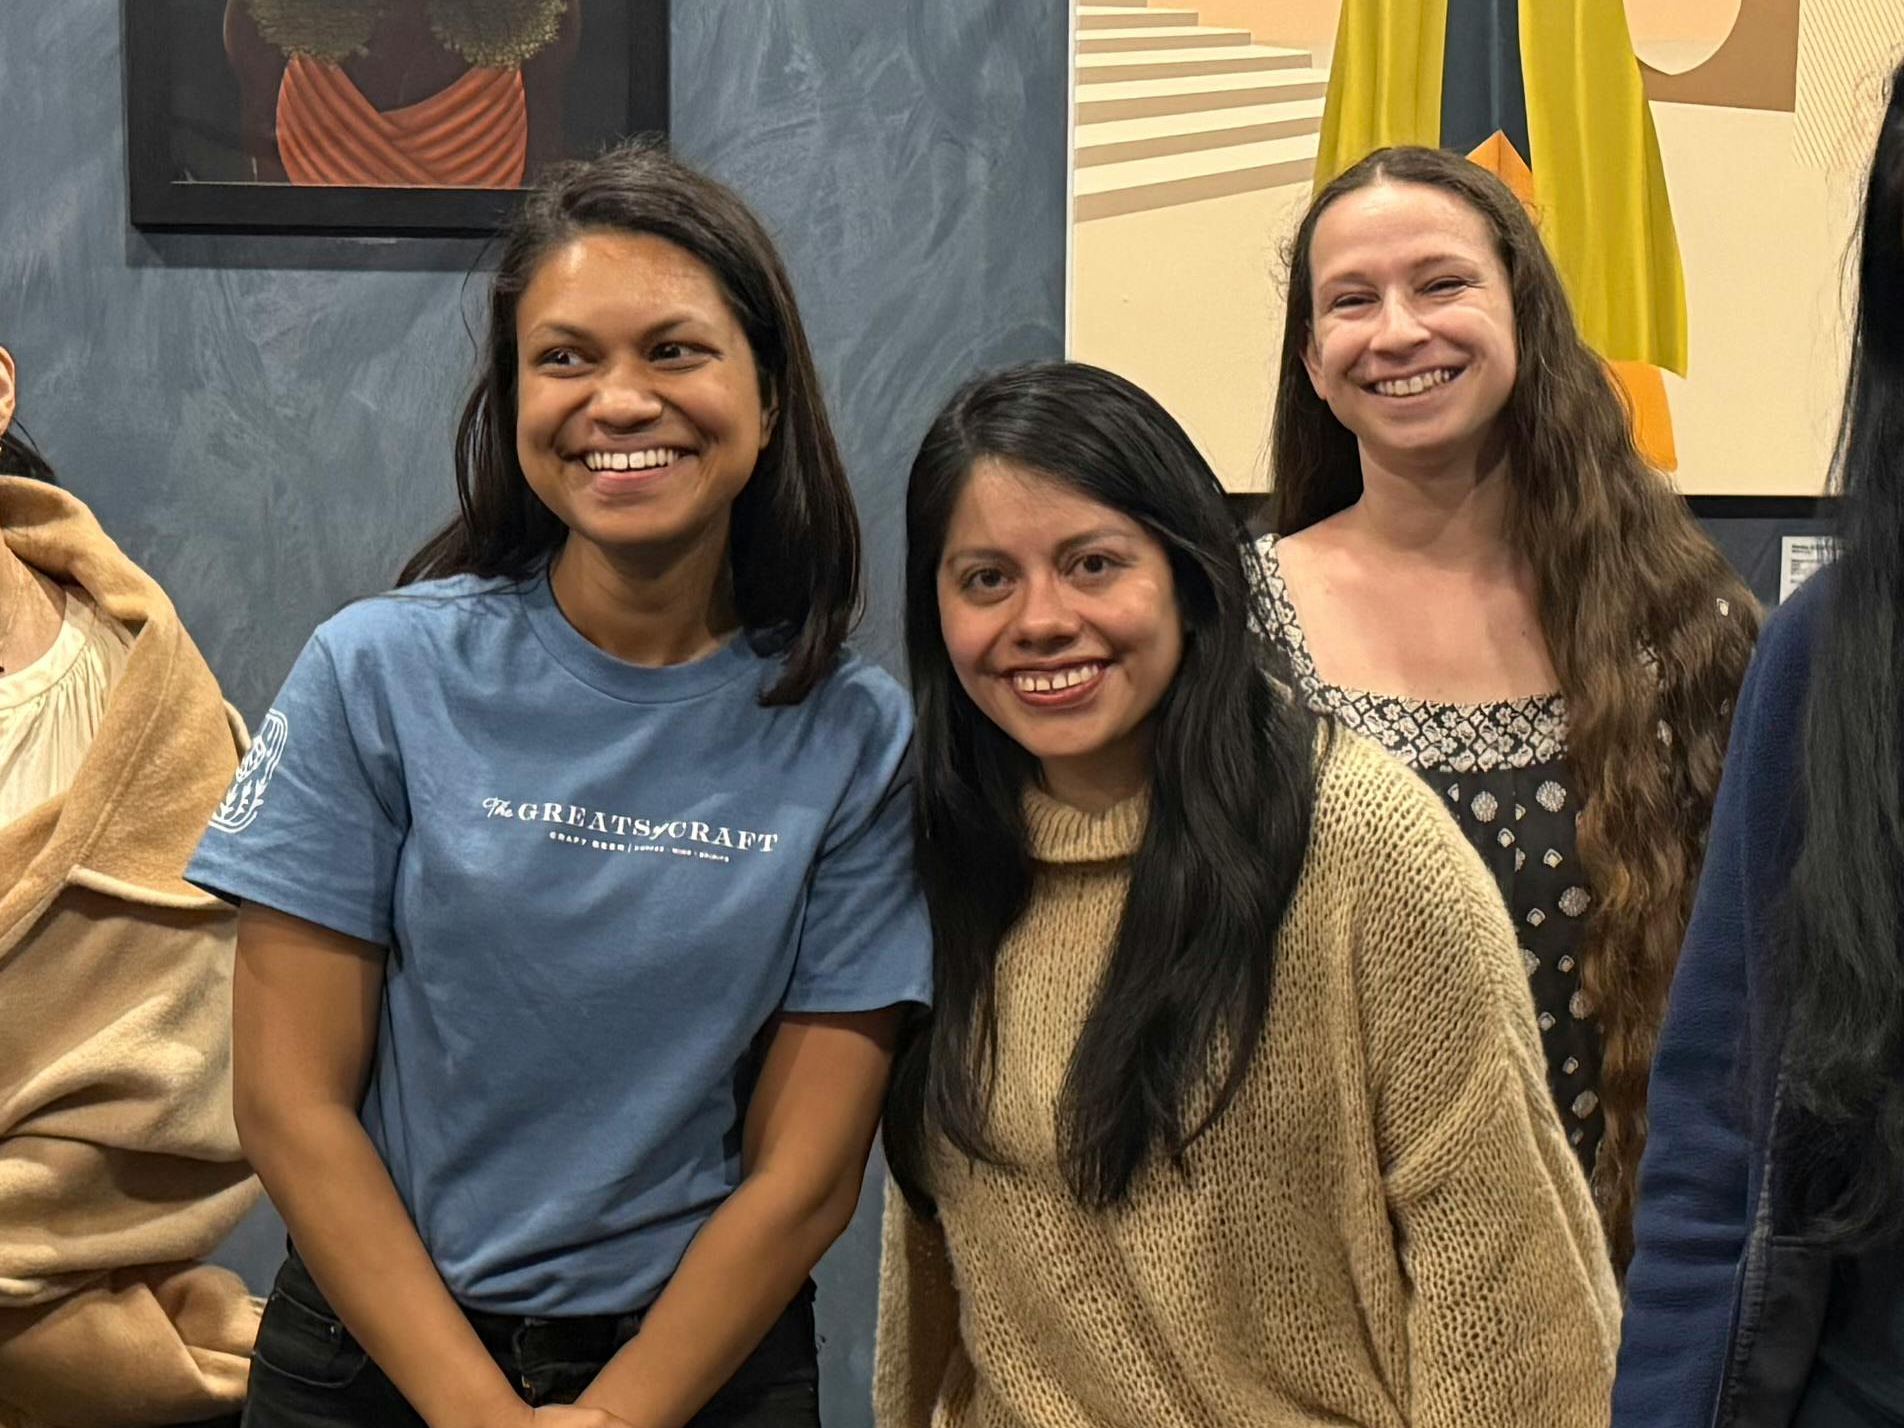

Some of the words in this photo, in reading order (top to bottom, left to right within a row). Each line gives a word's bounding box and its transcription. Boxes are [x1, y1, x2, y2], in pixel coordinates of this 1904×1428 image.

[482, 797, 514, 819] The
[518, 802, 651, 837] GREATS
[667, 820, 778, 853] CRAFT
